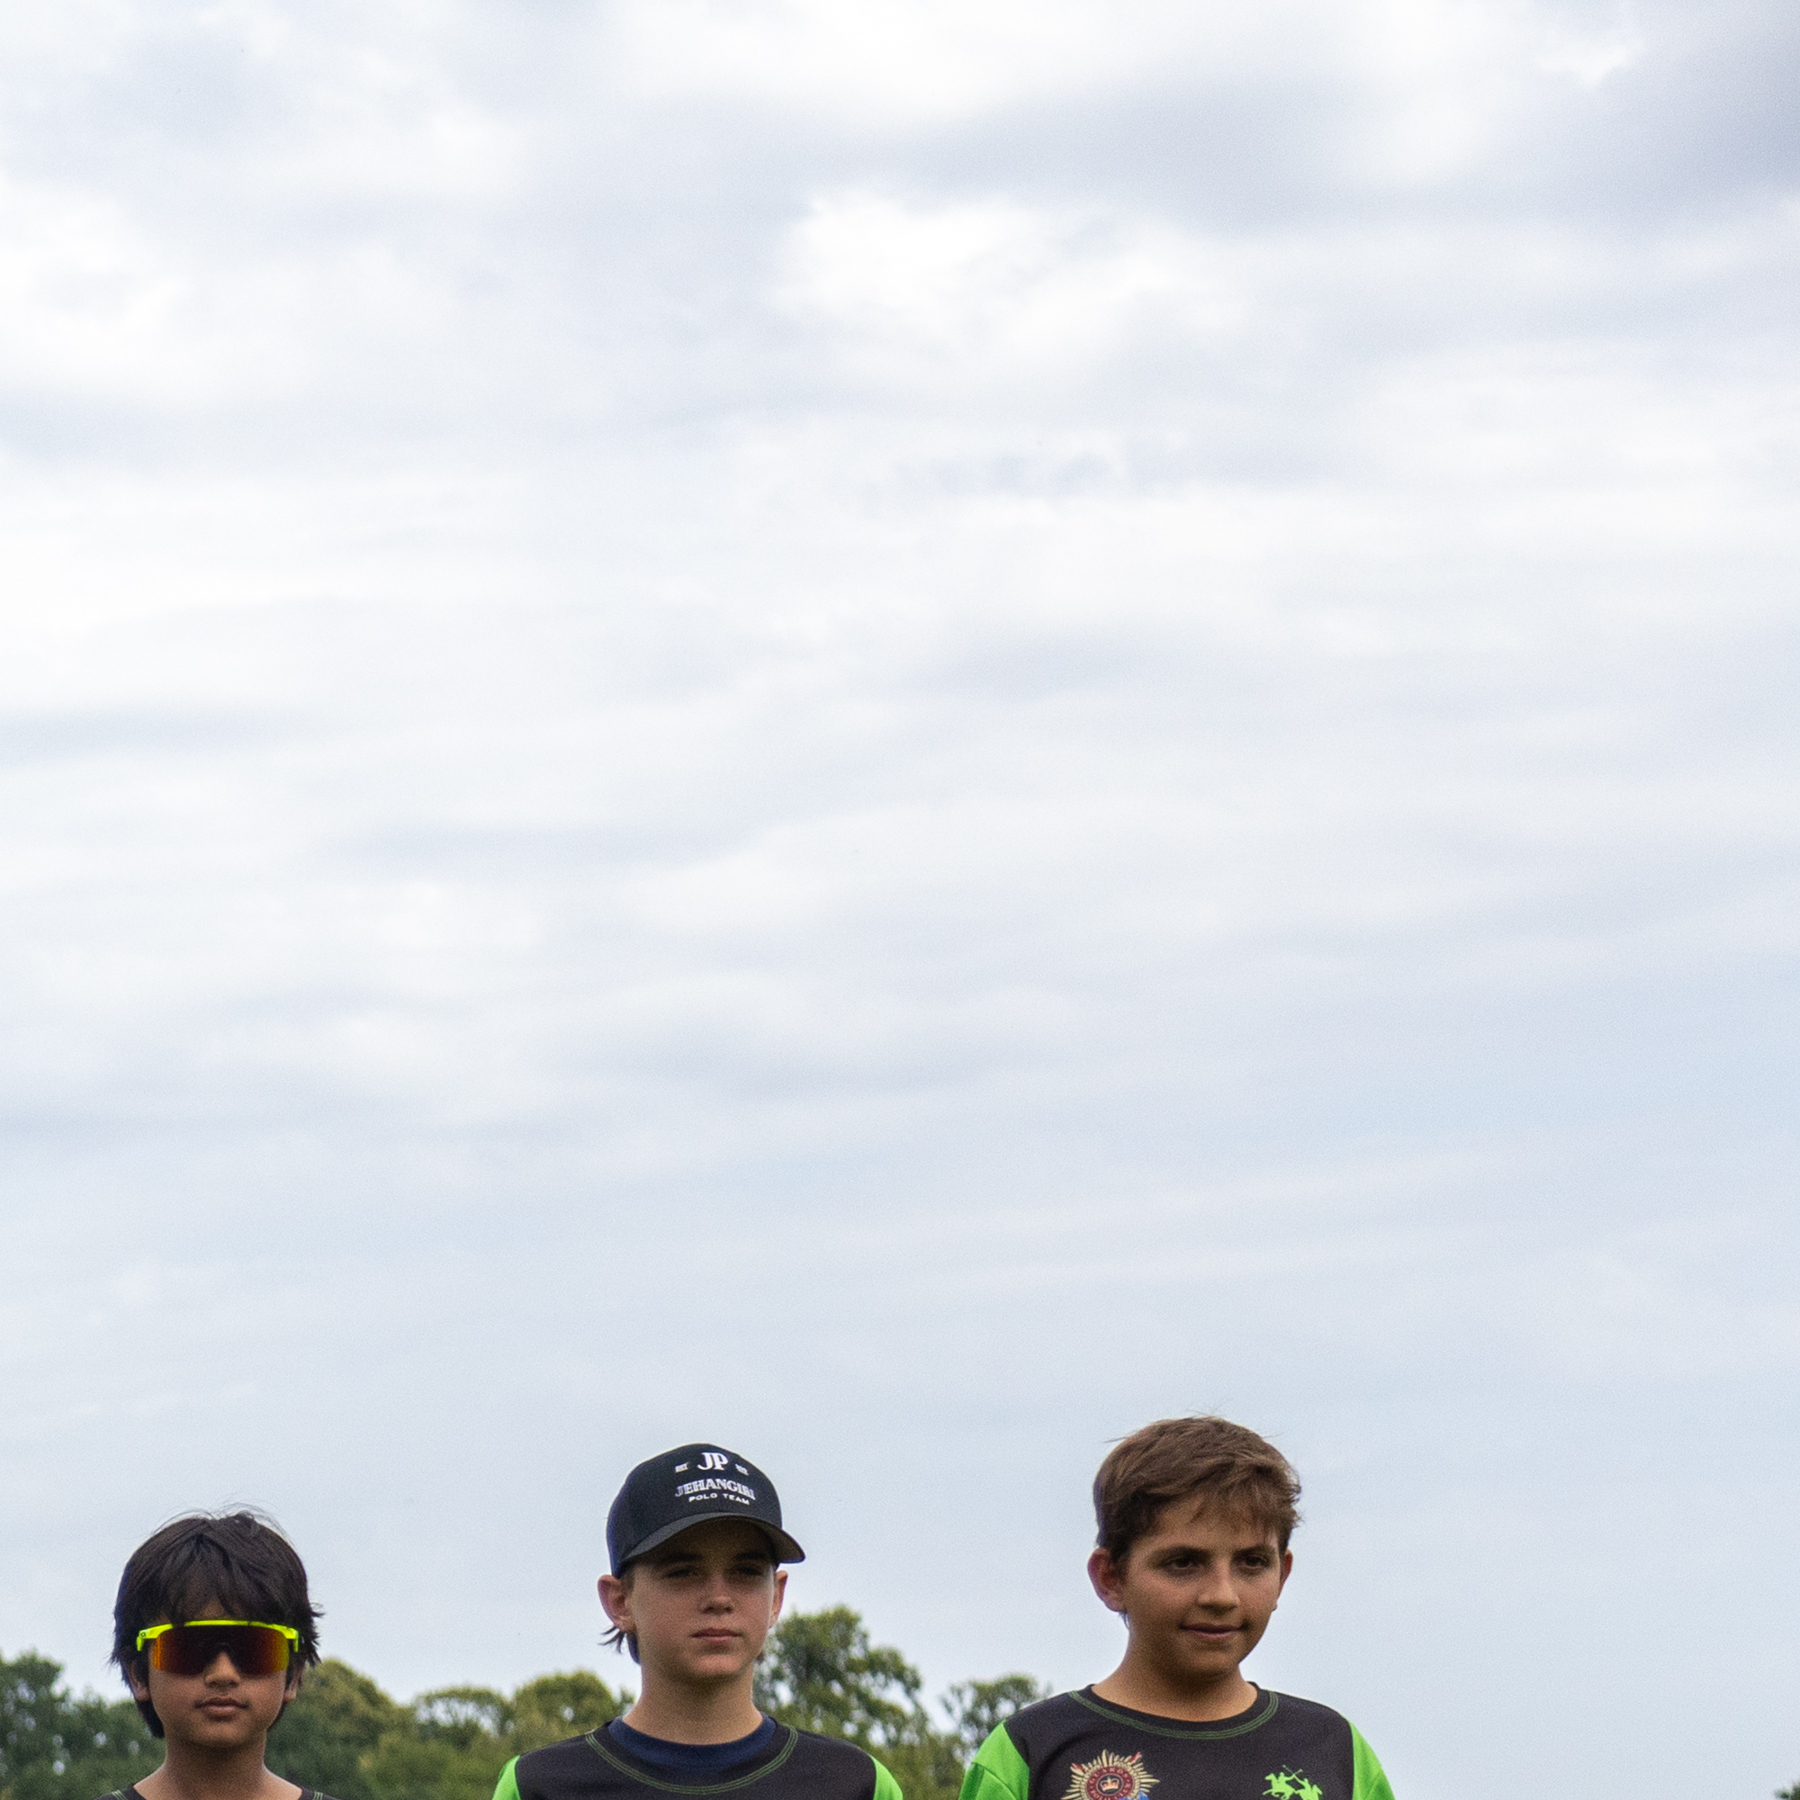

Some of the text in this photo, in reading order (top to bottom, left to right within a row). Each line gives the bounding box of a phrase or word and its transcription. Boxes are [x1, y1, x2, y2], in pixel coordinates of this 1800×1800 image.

[697, 1452, 729, 1471] JP
[688, 1492, 750, 1505] POLO TEAM
